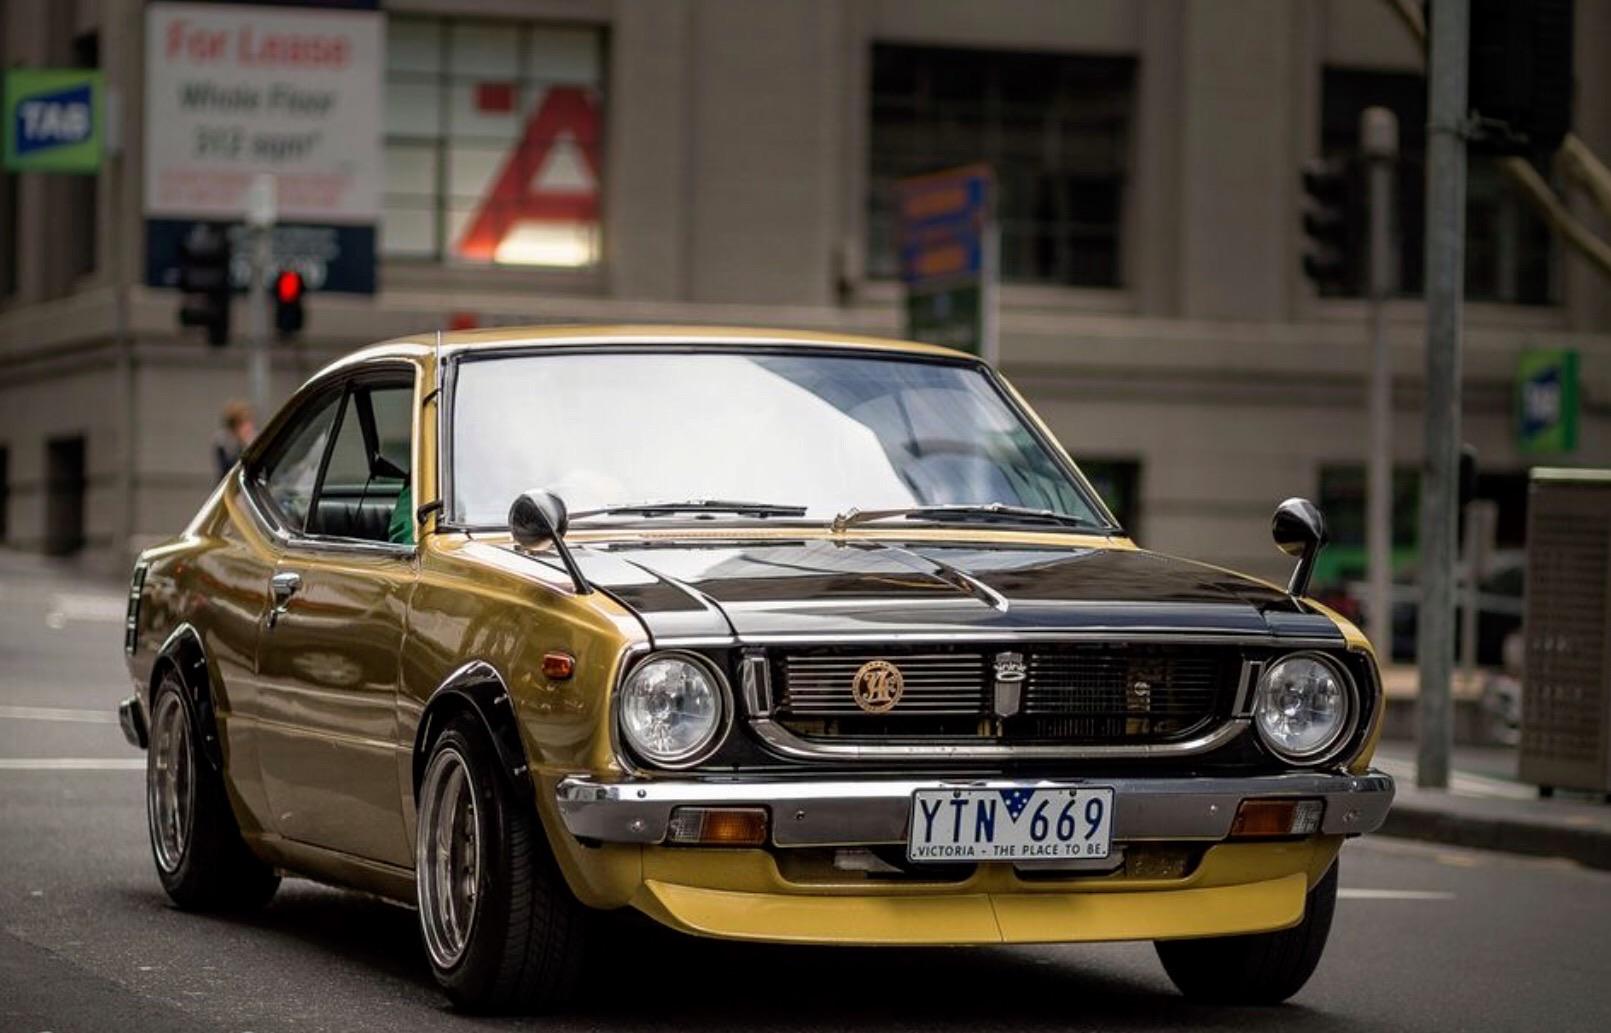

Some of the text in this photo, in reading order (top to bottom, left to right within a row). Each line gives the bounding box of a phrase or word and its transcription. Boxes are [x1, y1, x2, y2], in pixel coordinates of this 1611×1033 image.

[166, 19, 351, 71] For Lease
[22, 101, 89, 141] TAB
[920, 798, 1104, 843] YTN 669
[917, 845, 975, 857] VICTORIA
[993, 844, 1015, 856] THE
[1023, 844, 1058, 856] PLACE
[1064, 843, 1080, 855] TO
